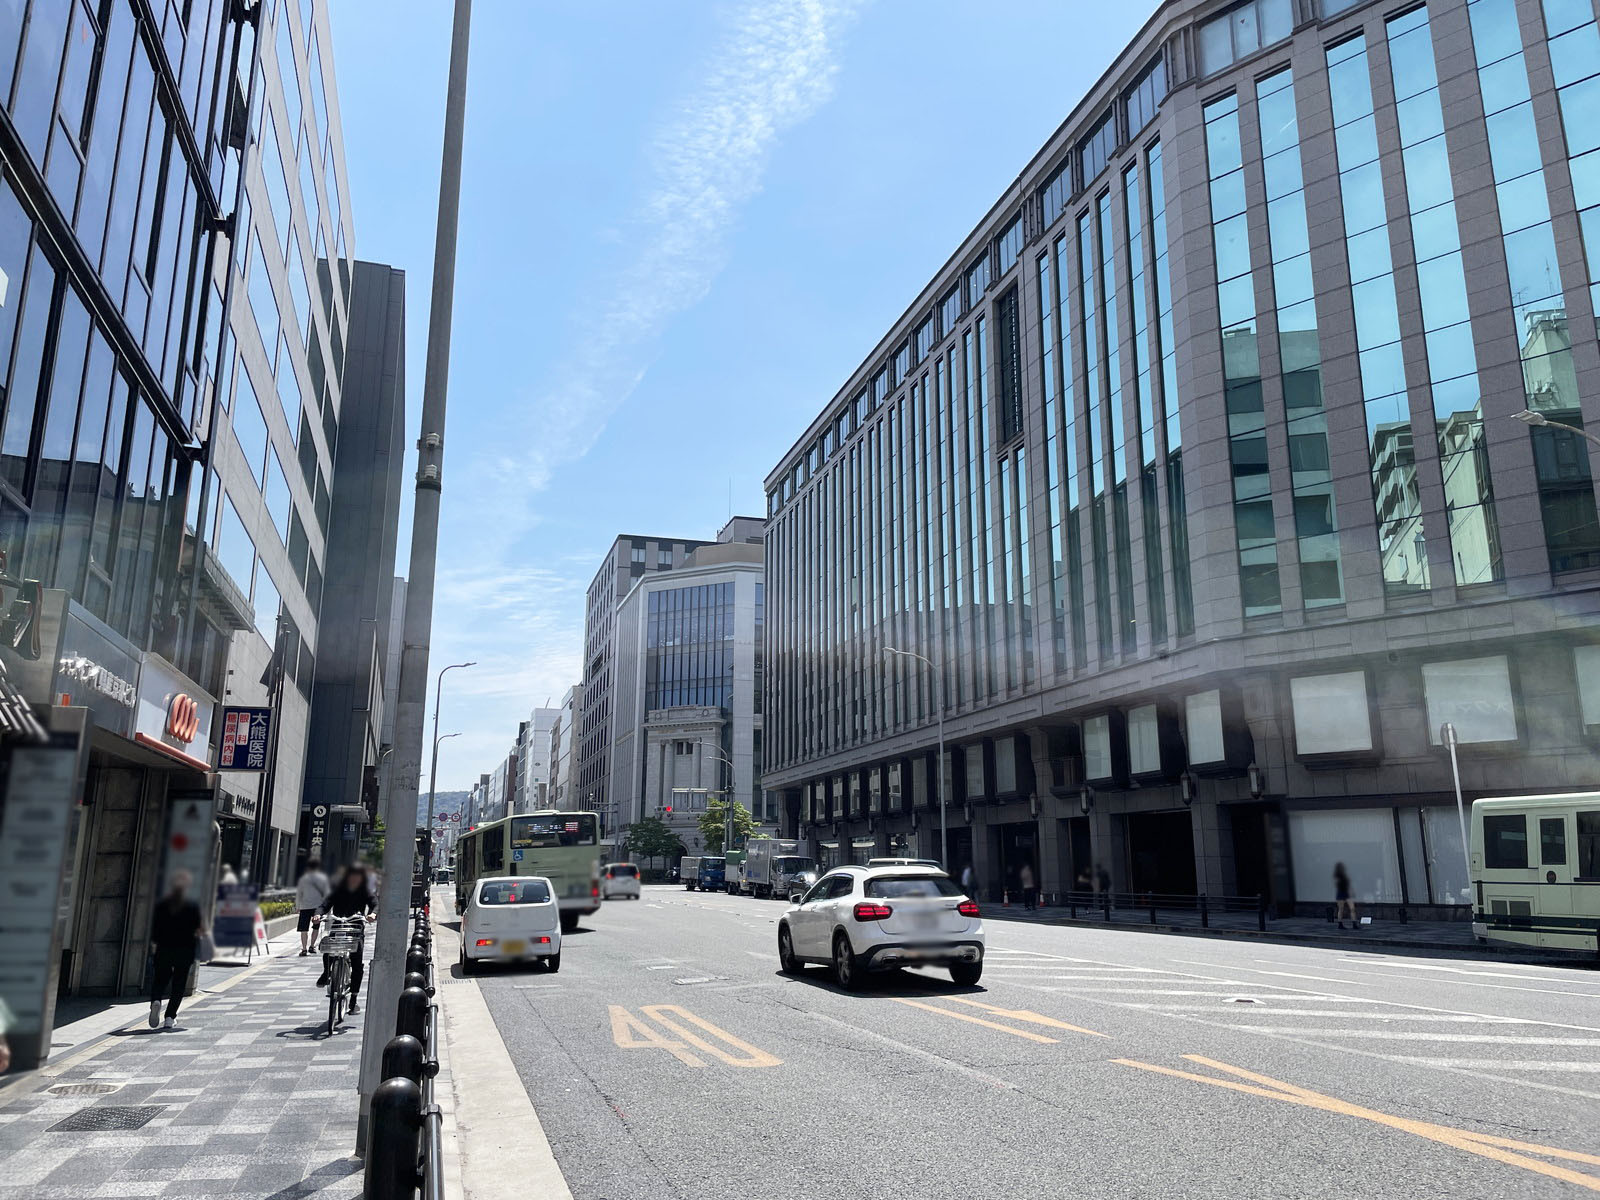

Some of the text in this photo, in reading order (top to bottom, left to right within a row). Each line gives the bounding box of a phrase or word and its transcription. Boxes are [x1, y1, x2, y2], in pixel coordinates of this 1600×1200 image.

[222, 713, 237, 764] 糖尿病内科
[237, 713, 250, 744] 眼科
[247, 712, 268, 768] 大熊医院
[607, 1004, 785, 1069] 40
